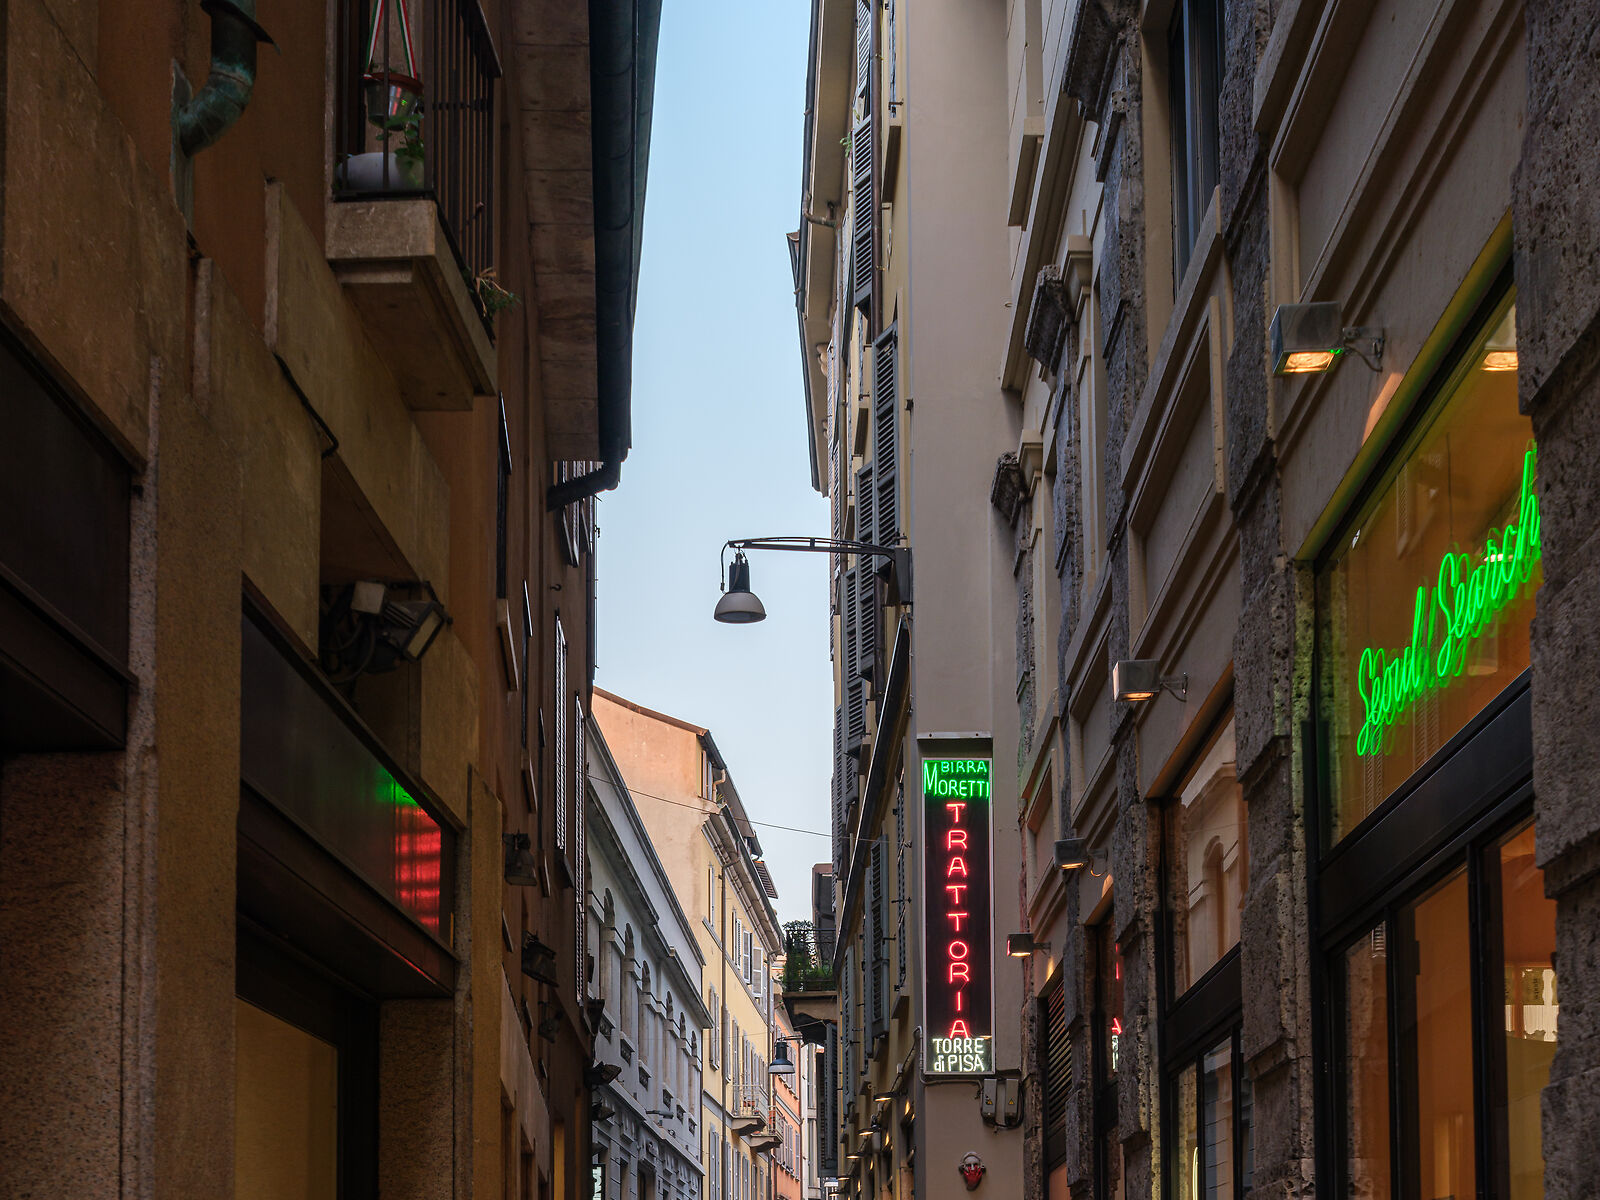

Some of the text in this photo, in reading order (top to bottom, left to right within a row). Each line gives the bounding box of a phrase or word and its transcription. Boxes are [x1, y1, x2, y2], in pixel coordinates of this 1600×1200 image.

[1356, 449, 1541, 756] Seoul Search
[923, 762, 990, 797] MORETTI
[941, 760, 987, 773] BIRRA
[946, 803, 969, 1038] TRATTORIA
[932, 1037, 985, 1054] TORRE
[934, 1053, 985, 1072] di PISA
